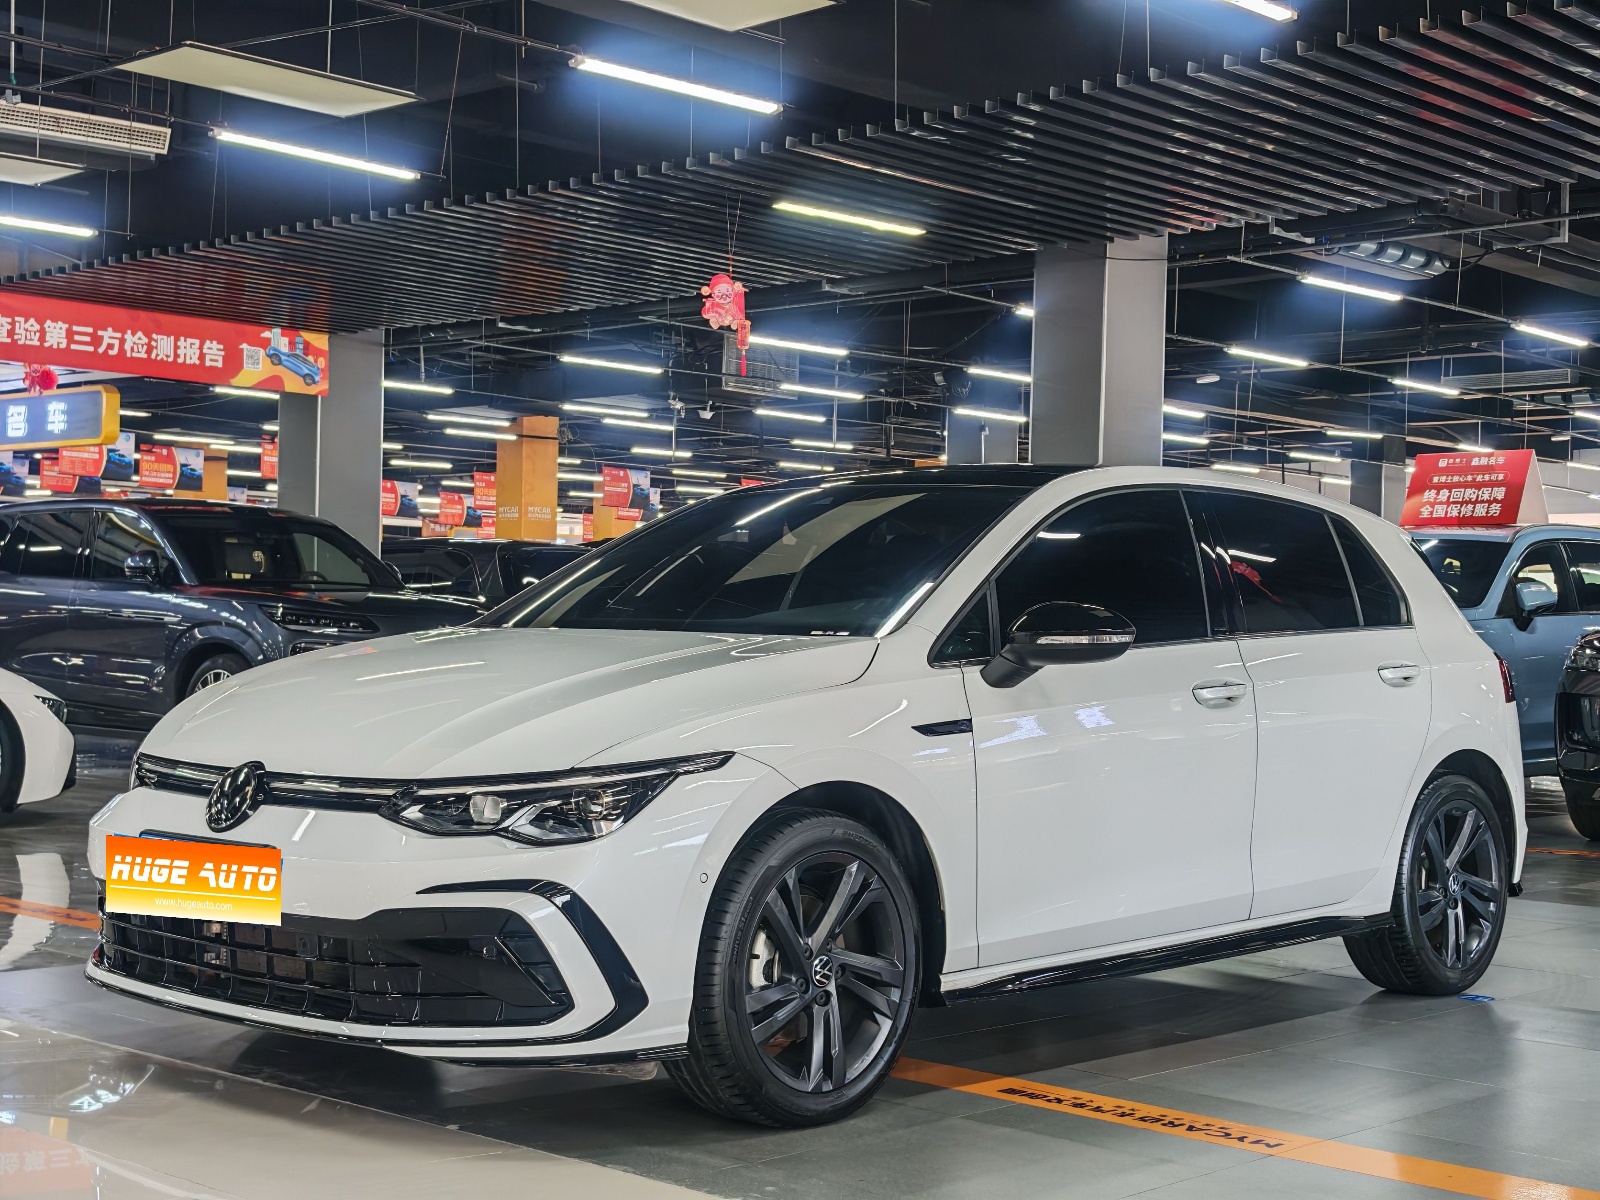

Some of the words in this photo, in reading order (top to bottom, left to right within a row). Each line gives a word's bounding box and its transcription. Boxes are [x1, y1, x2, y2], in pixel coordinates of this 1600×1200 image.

[1422, 486, 1507, 502] 终身回购保障
[527, 506, 551, 514] MYCAR
[1419, 503, 1503, 518] 全国保修服务
